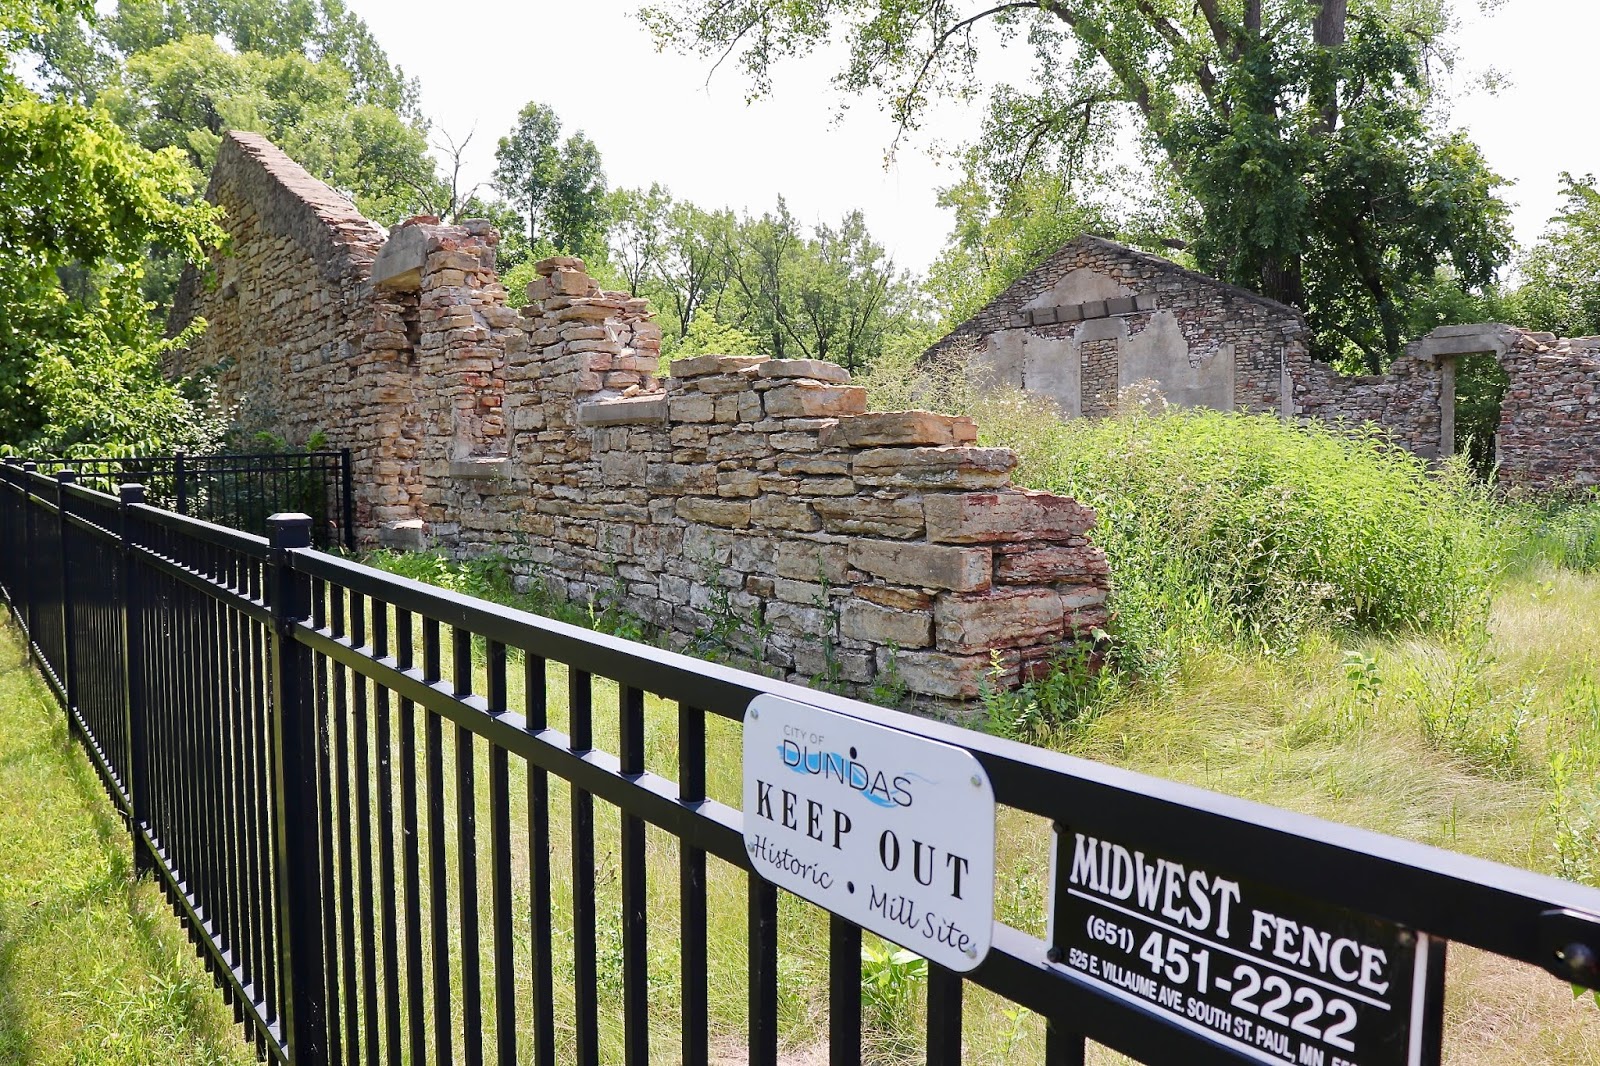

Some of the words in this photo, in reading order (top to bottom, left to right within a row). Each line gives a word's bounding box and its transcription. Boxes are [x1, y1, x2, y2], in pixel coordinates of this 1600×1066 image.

[783, 724, 807, 741] CITY
[810, 733, 825, 746] OF
[783, 739, 913, 808] DUNDAS
[754, 834, 833, 889] Historic
[869, 884, 920, 929] Mill
[922, 912, 972, 953] Site
[756, 779, 852, 851] KEEP
[879, 829, 969, 900] OUT
[1069, 833, 1240, 938] MIDWEST
[1250, 909, 1390, 995] FENCE
[1069, 948, 1088, 970] 525
[1089, 955, 1100, 975] E.
[1102, 960, 1157, 1001] VILLAUME
[1158, 985, 1185, 1013] AVE.
[1187, 997, 1232, 1033] SOUTH
[1233, 1016, 1253, 1042] ST.
[1256, 1025, 1296, 1064] PAUL,
[1299, 1043, 1324, 1066] MN
[1087, 915, 1135, 954] (651)
[1139, 931, 1358, 1052] 451-2222
